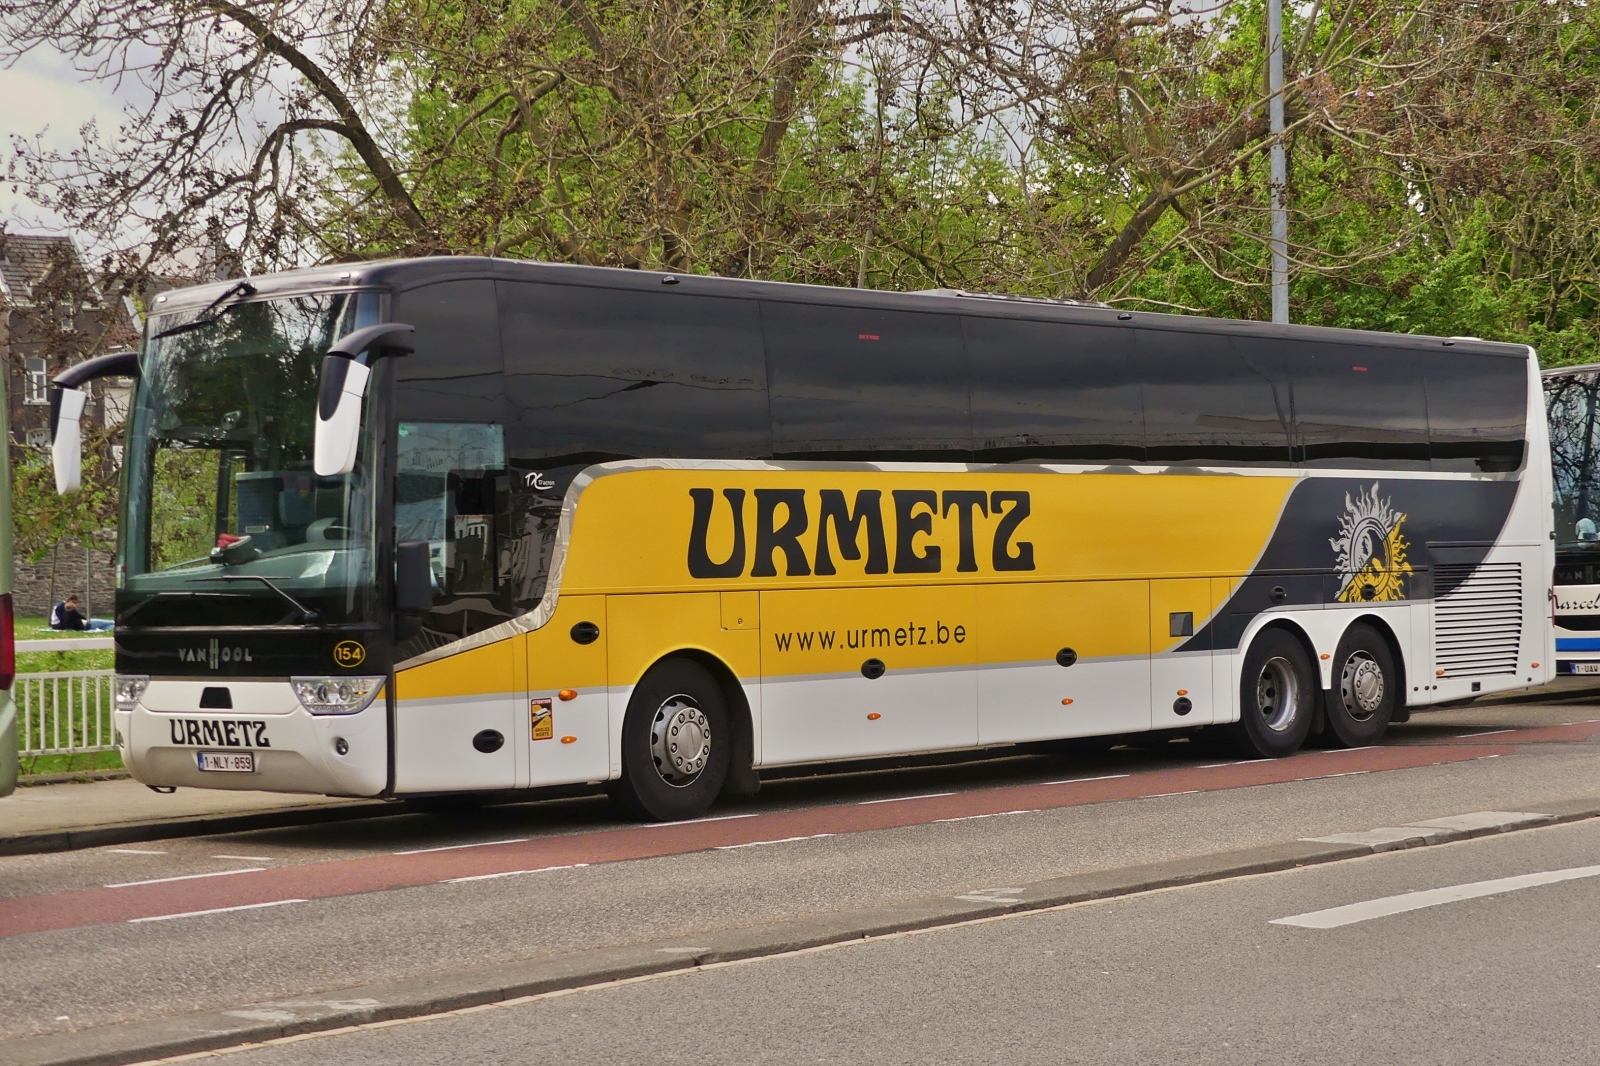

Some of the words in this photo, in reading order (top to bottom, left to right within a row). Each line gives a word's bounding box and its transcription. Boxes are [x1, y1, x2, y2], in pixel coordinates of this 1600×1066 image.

[688, 488, 1036, 578] URMETZ
[775, 621, 967, 652] www.urmetz.be
[337, 647, 362, 660] 154
[169, 719, 271, 747] URMETZ
[204, 757, 251, 769] 1-NLY-859
